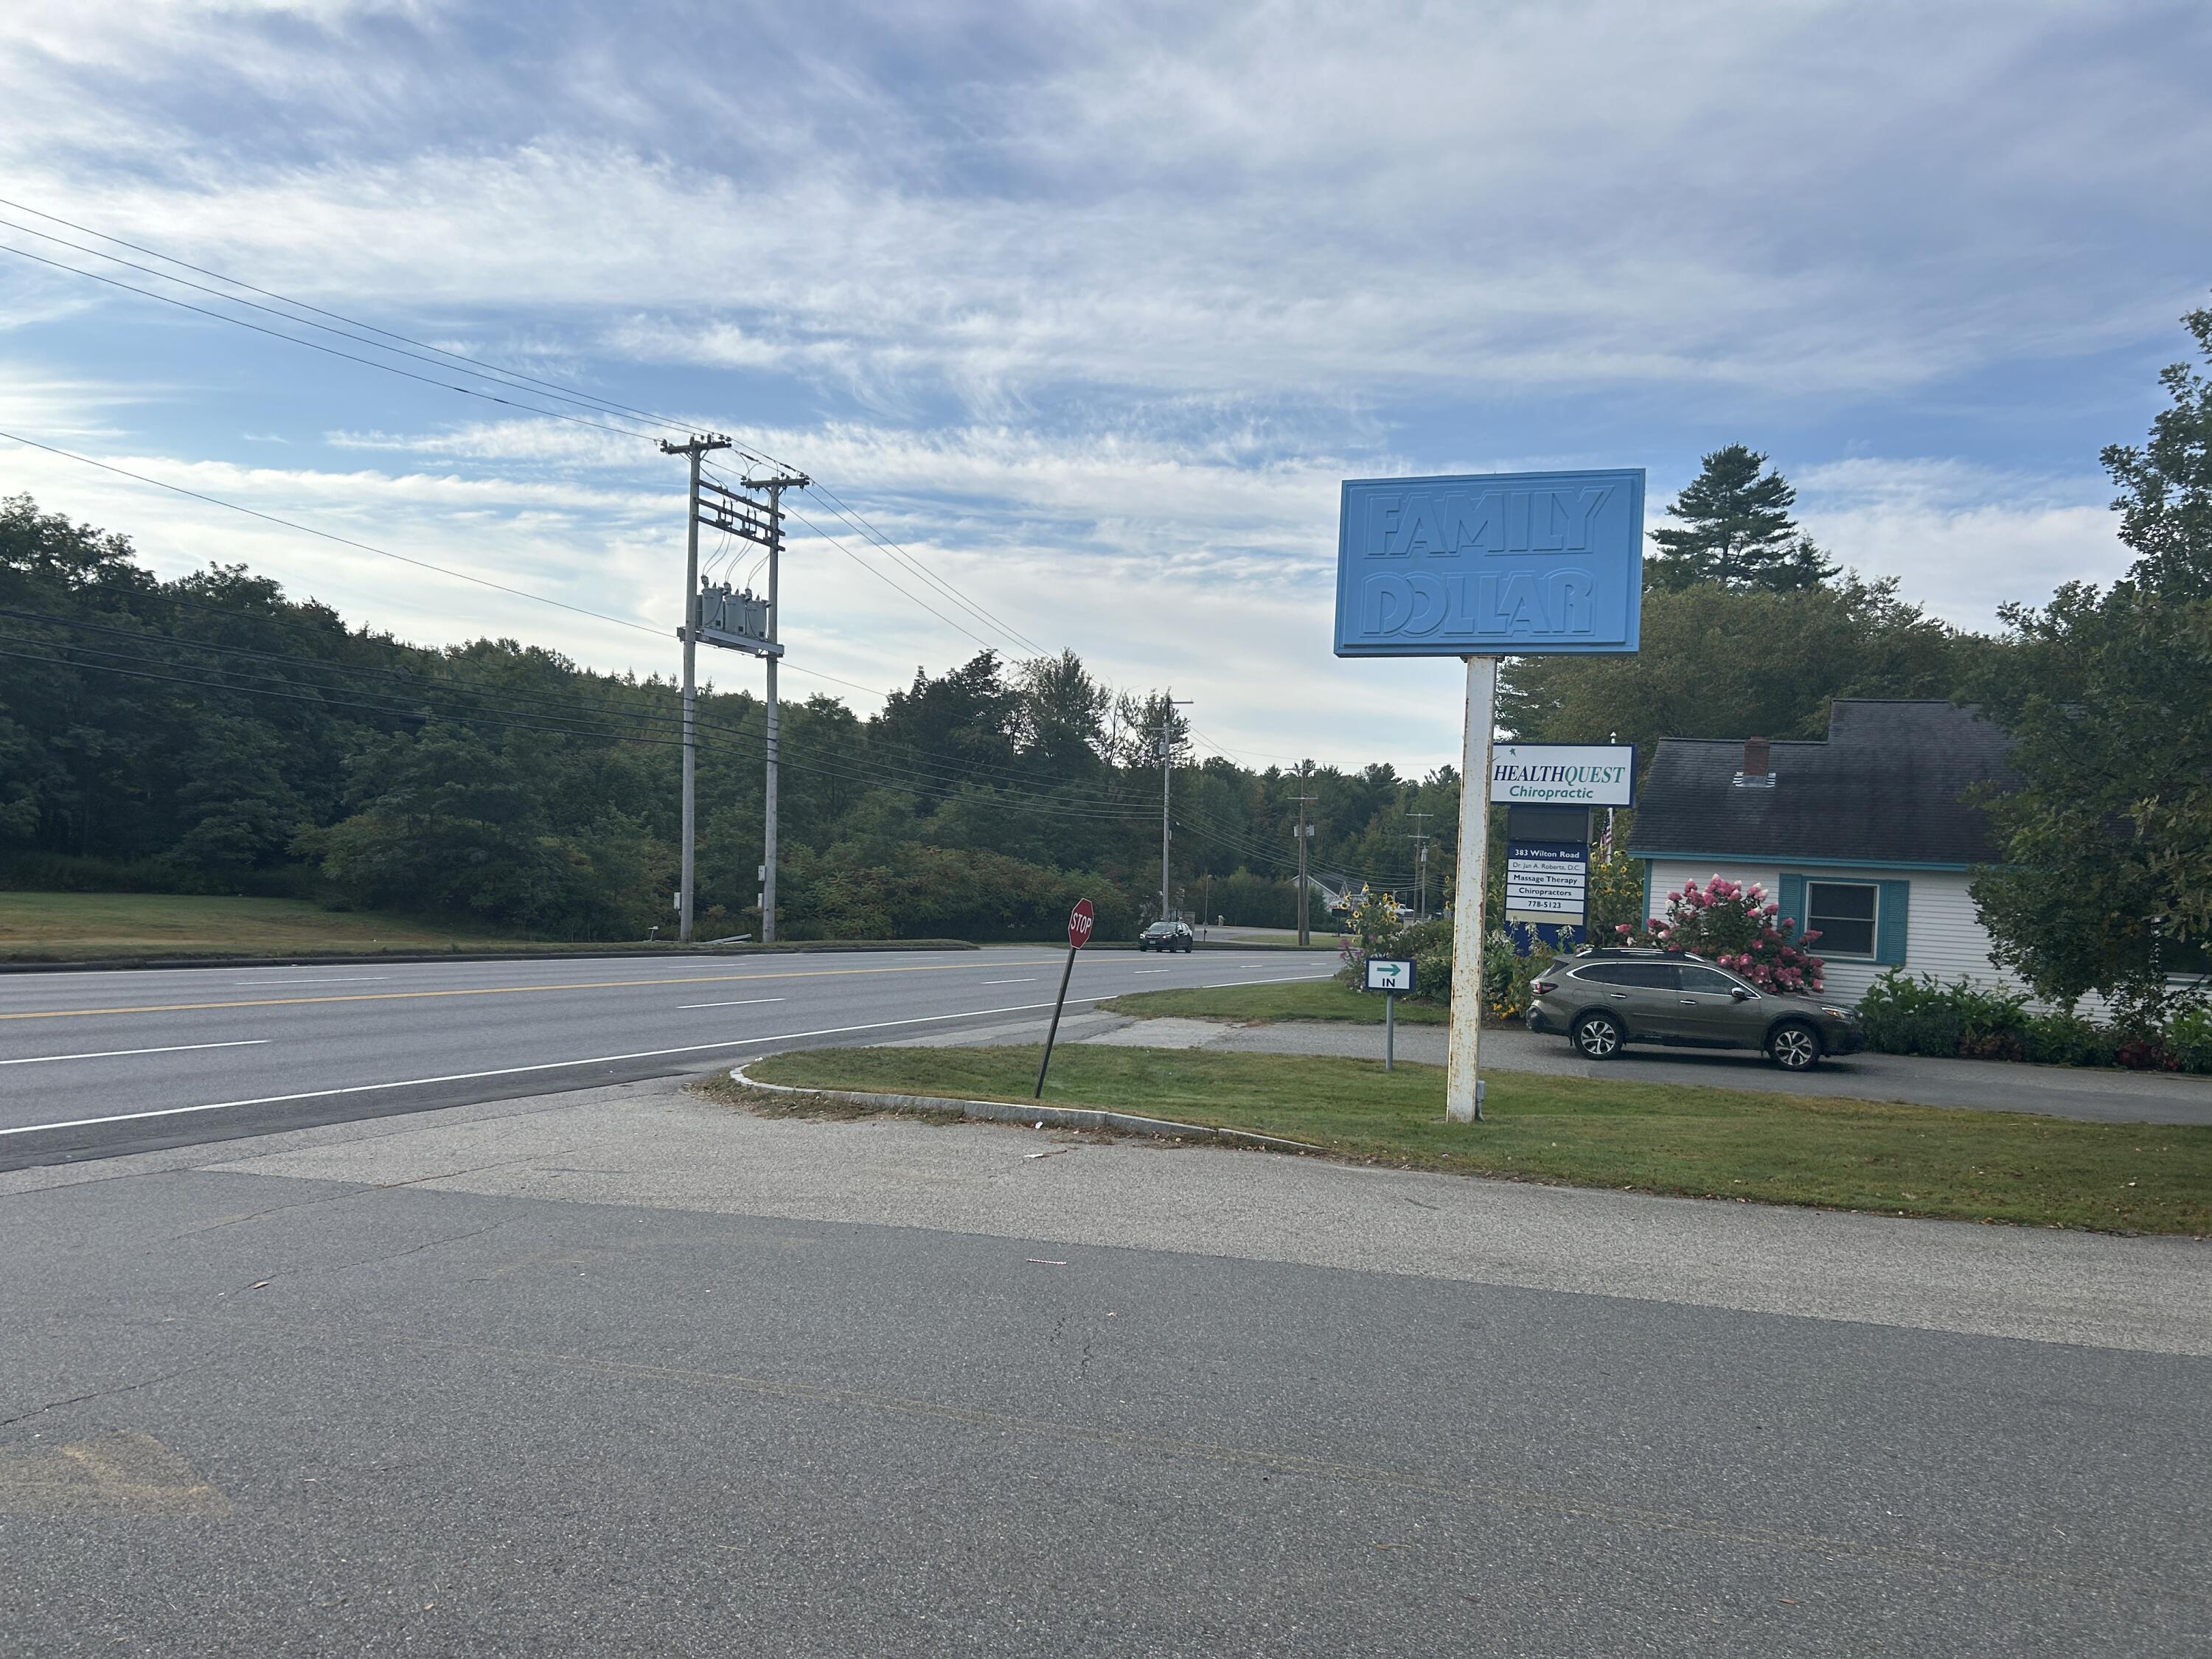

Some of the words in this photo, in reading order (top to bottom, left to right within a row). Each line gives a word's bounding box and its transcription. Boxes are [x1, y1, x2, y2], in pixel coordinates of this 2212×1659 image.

[1366, 486, 1615, 557] FAMILY
[1360, 568, 1596, 638] DOLLAR
[1493, 765, 1625, 785] HEALTHQUEST
[1509, 785, 1593, 800] Chiropractic
[1530, 849, 1557, 858] Wilton
[1513, 874, 1545, 883] Massage
[1545, 876, 1577, 885] Therapy
[1519, 887, 1572, 896] Chiropractors
[1528, 900, 1562, 908] 778-5123
[1071, 912, 1091, 933] STOP
[1382, 978, 1395, 987] IN
